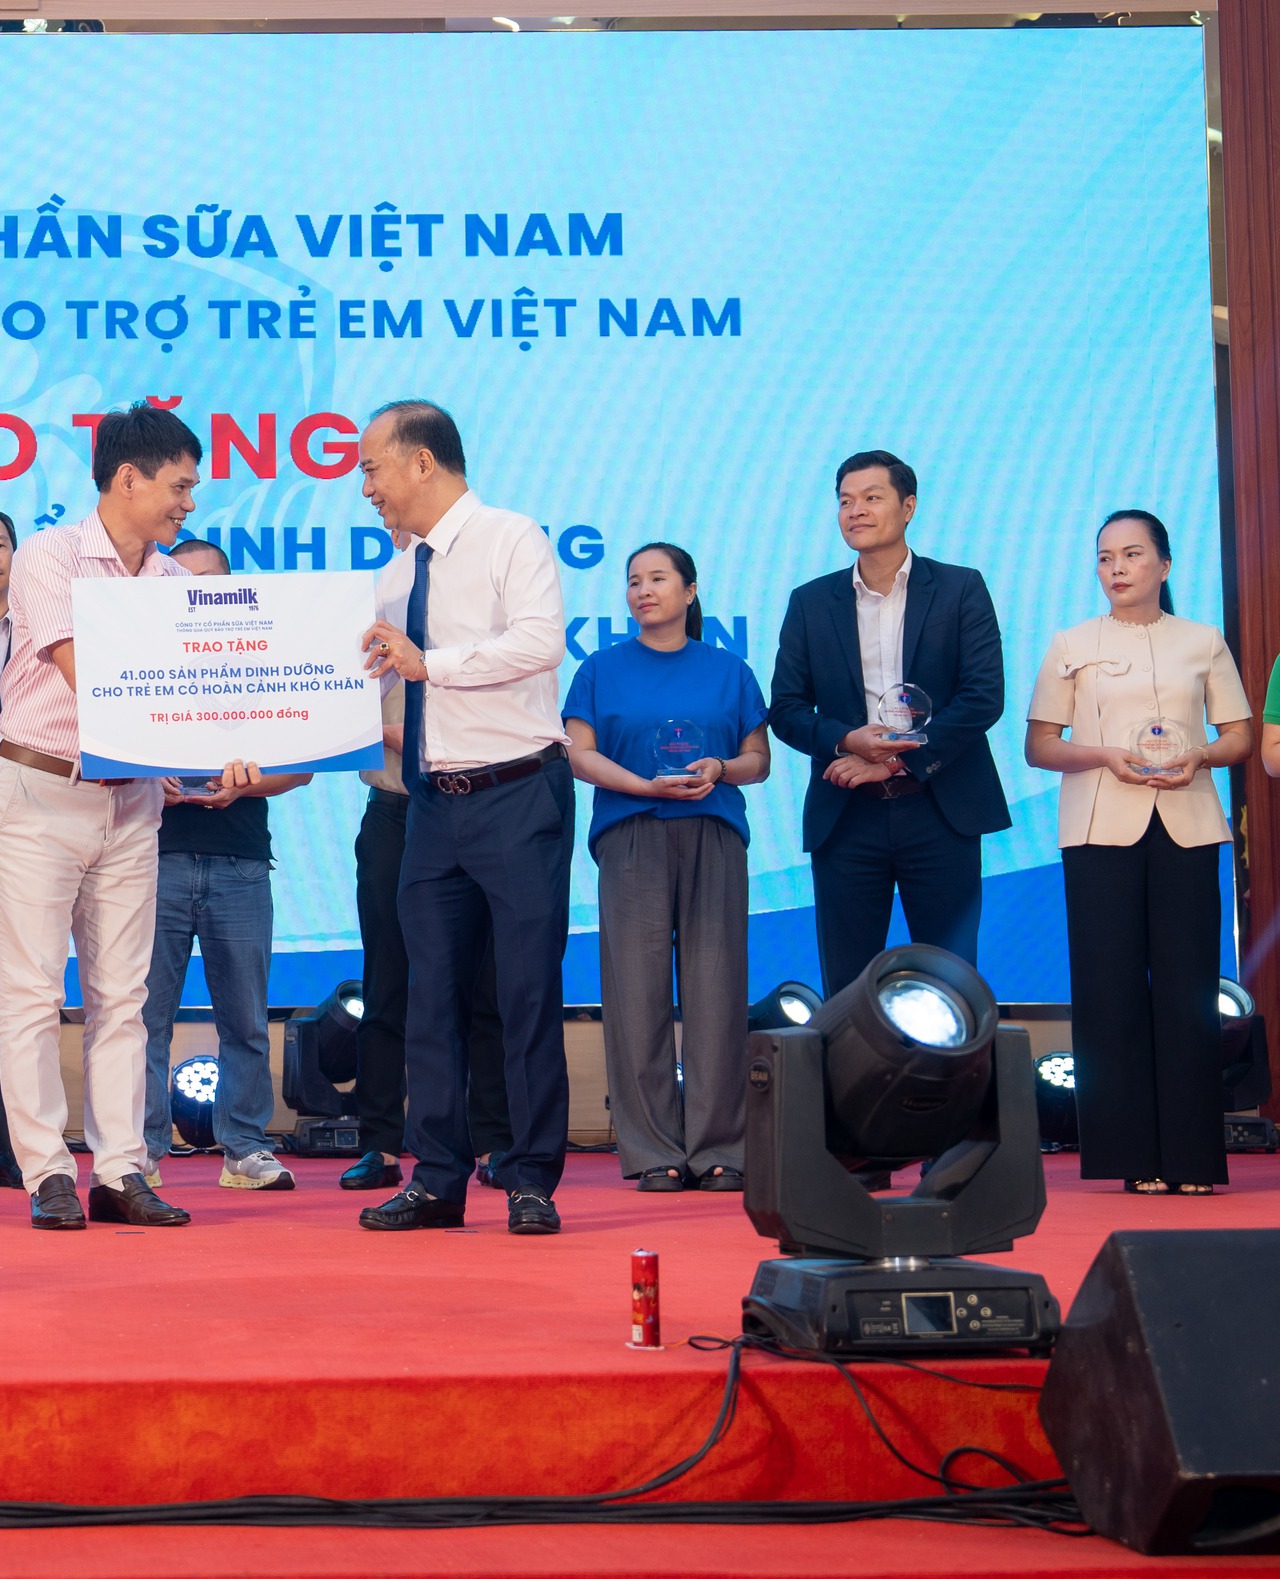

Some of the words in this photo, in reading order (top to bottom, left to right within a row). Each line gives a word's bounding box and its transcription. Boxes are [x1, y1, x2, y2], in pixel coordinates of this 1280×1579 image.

[142, 203, 278, 259] SỮA
[295, 201, 444, 272] VIỆT
[464, 212, 623, 257] NAM
[65, 294, 189, 354] TRỢ
[207, 284, 317, 339] TRẺ
[339, 299, 423, 339] EM
[443, 286, 577, 352] VIỆT
[598, 297, 742, 337] NAM
[187, 588, 258, 605] Vinamilk
[182, 641, 223, 653] TRAO
[227, 637, 268, 655] TẶNG
[120, 669, 165, 681] 41.000
[169, 665, 197, 679] SẢN
[201, 662, 242, 678] PHẨM
[245, 666, 280, 678] DINH
[283, 662, 335, 676] DƯỠNG
[92, 687, 123, 698] CHO
[126, 682, 151, 697] TRẺ
[155, 685, 174, 696] EM
[178, 681, 199, 696] CÓ
[202, 680, 243, 695] HOÀN
[246, 678, 286, 693] CẢNH
[290, 677, 321, 692] KHÓ
[324, 676, 364, 690] KHĂN
[150, 713, 169, 725] TRỊ
[172, 710, 193, 722] GIÁ
[196, 709, 273, 722] 300.000.000
[276, 706, 309, 721] đồng
